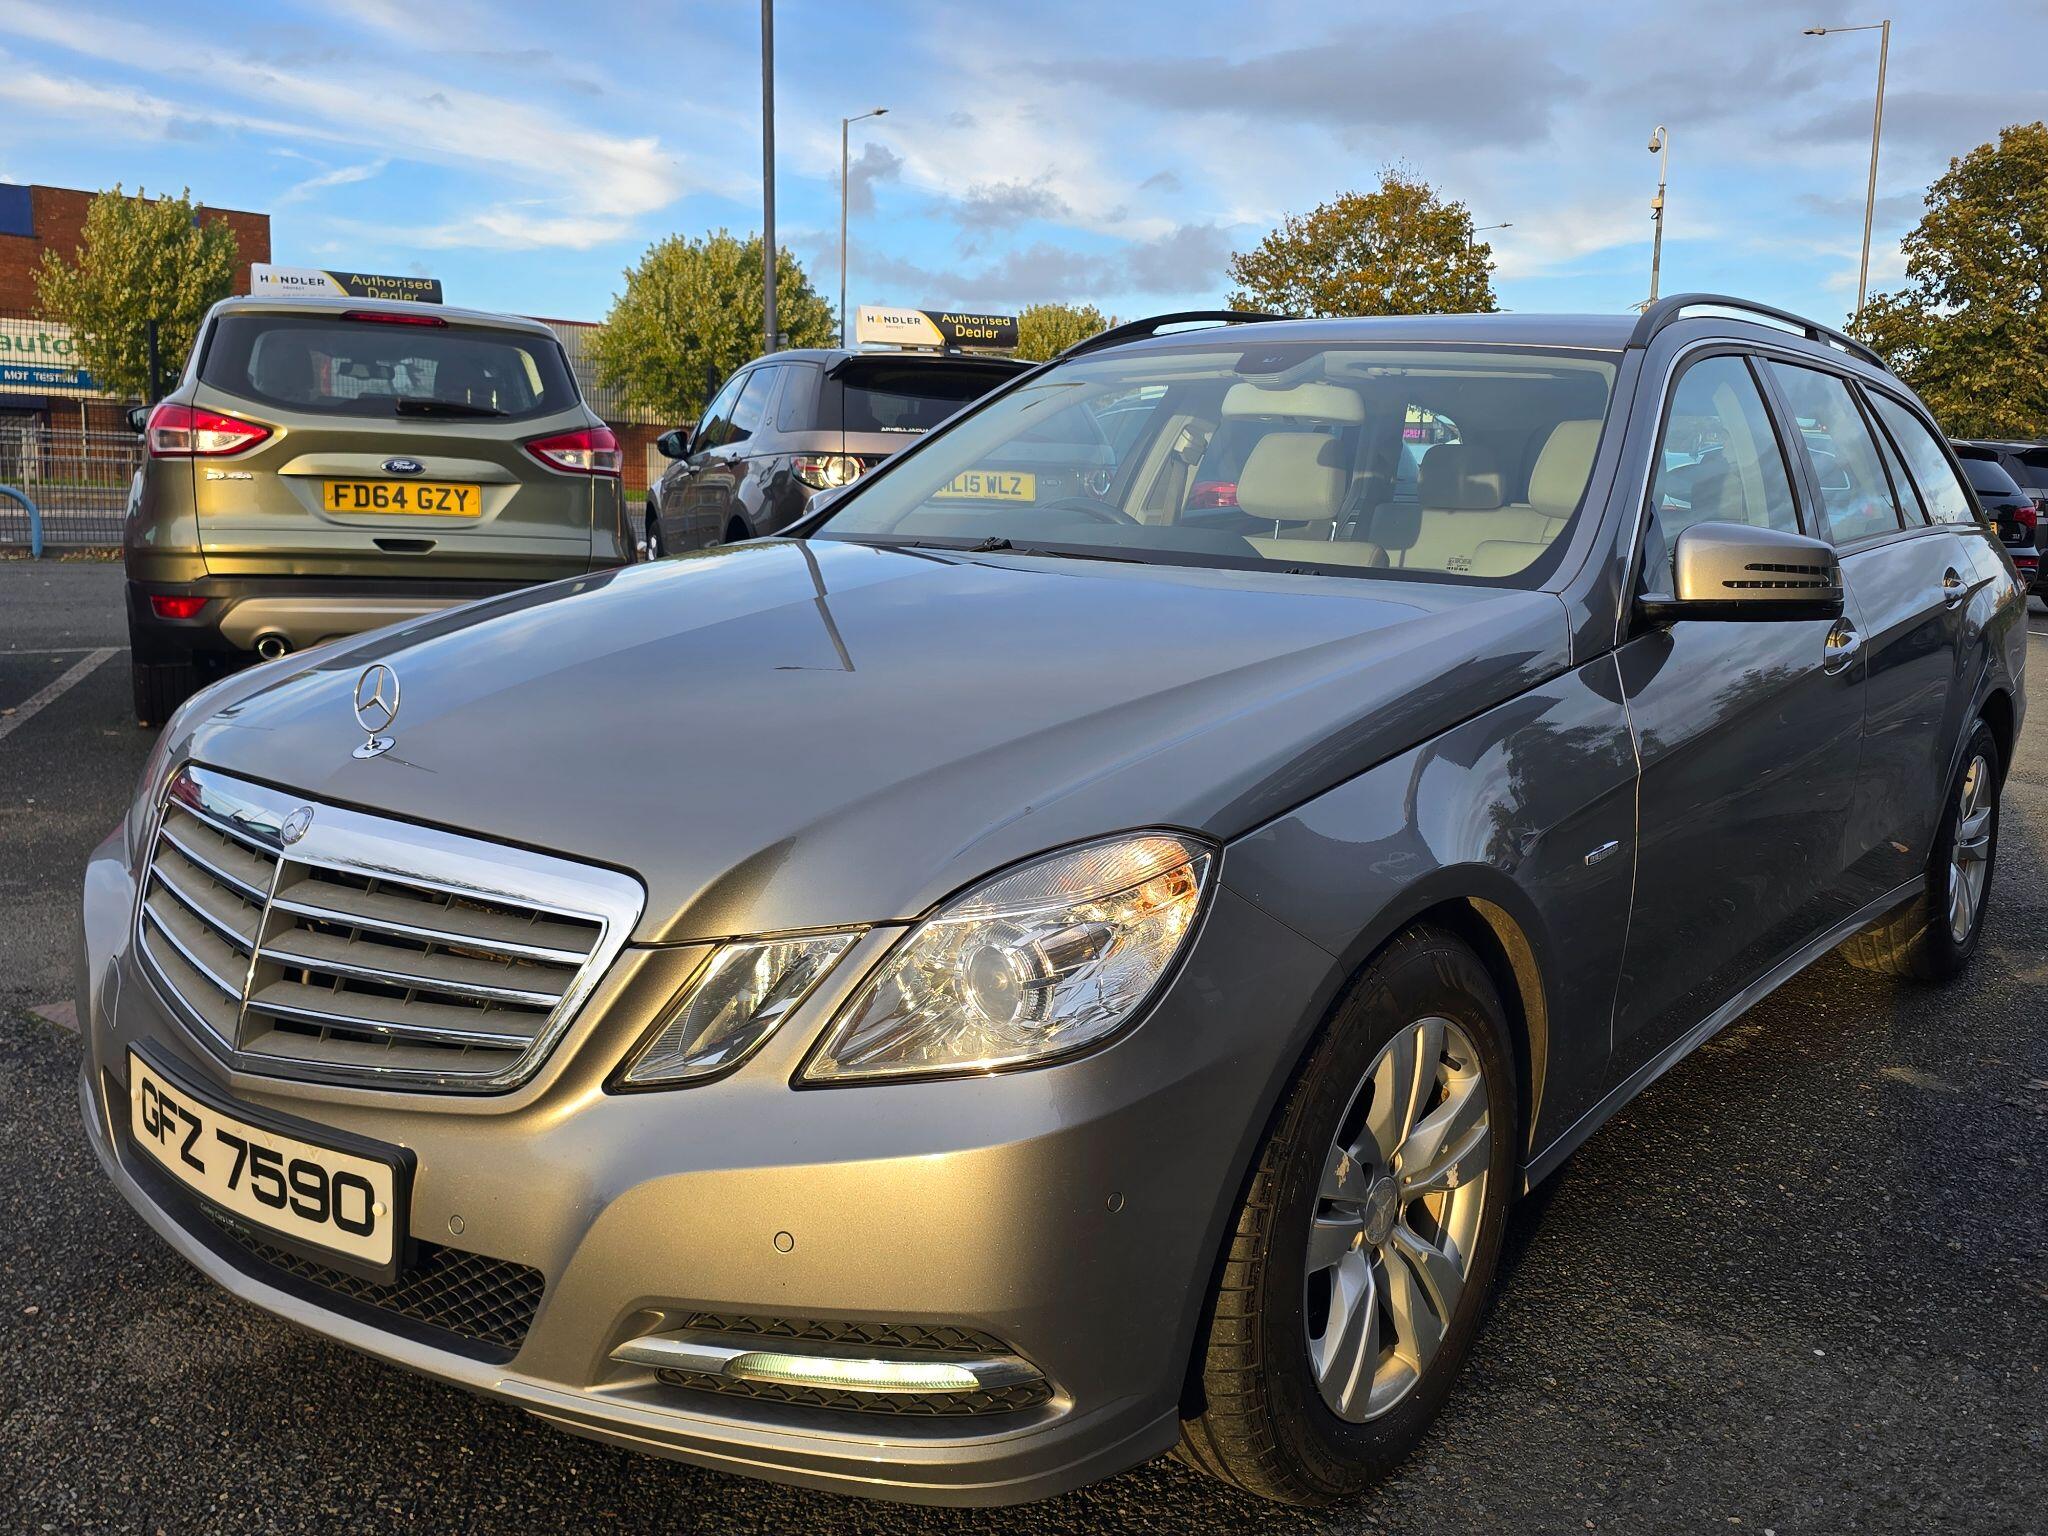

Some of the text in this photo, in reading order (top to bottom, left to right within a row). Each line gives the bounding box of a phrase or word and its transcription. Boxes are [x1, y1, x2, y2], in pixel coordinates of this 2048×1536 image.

[351, 275, 433, 291] Authorised
[367, 287, 419, 301] Dealer
[941, 314, 1011, 327] Authorised
[955, 325, 999, 339] Dealer
[4, 370, 29, 381] MOT
[392, 460, 416, 471] Ford
[986, 476, 1022, 495] WLZ
[334, 484, 469, 511] FD64 GZY
[141, 1076, 375, 1238] GFZ 7590
